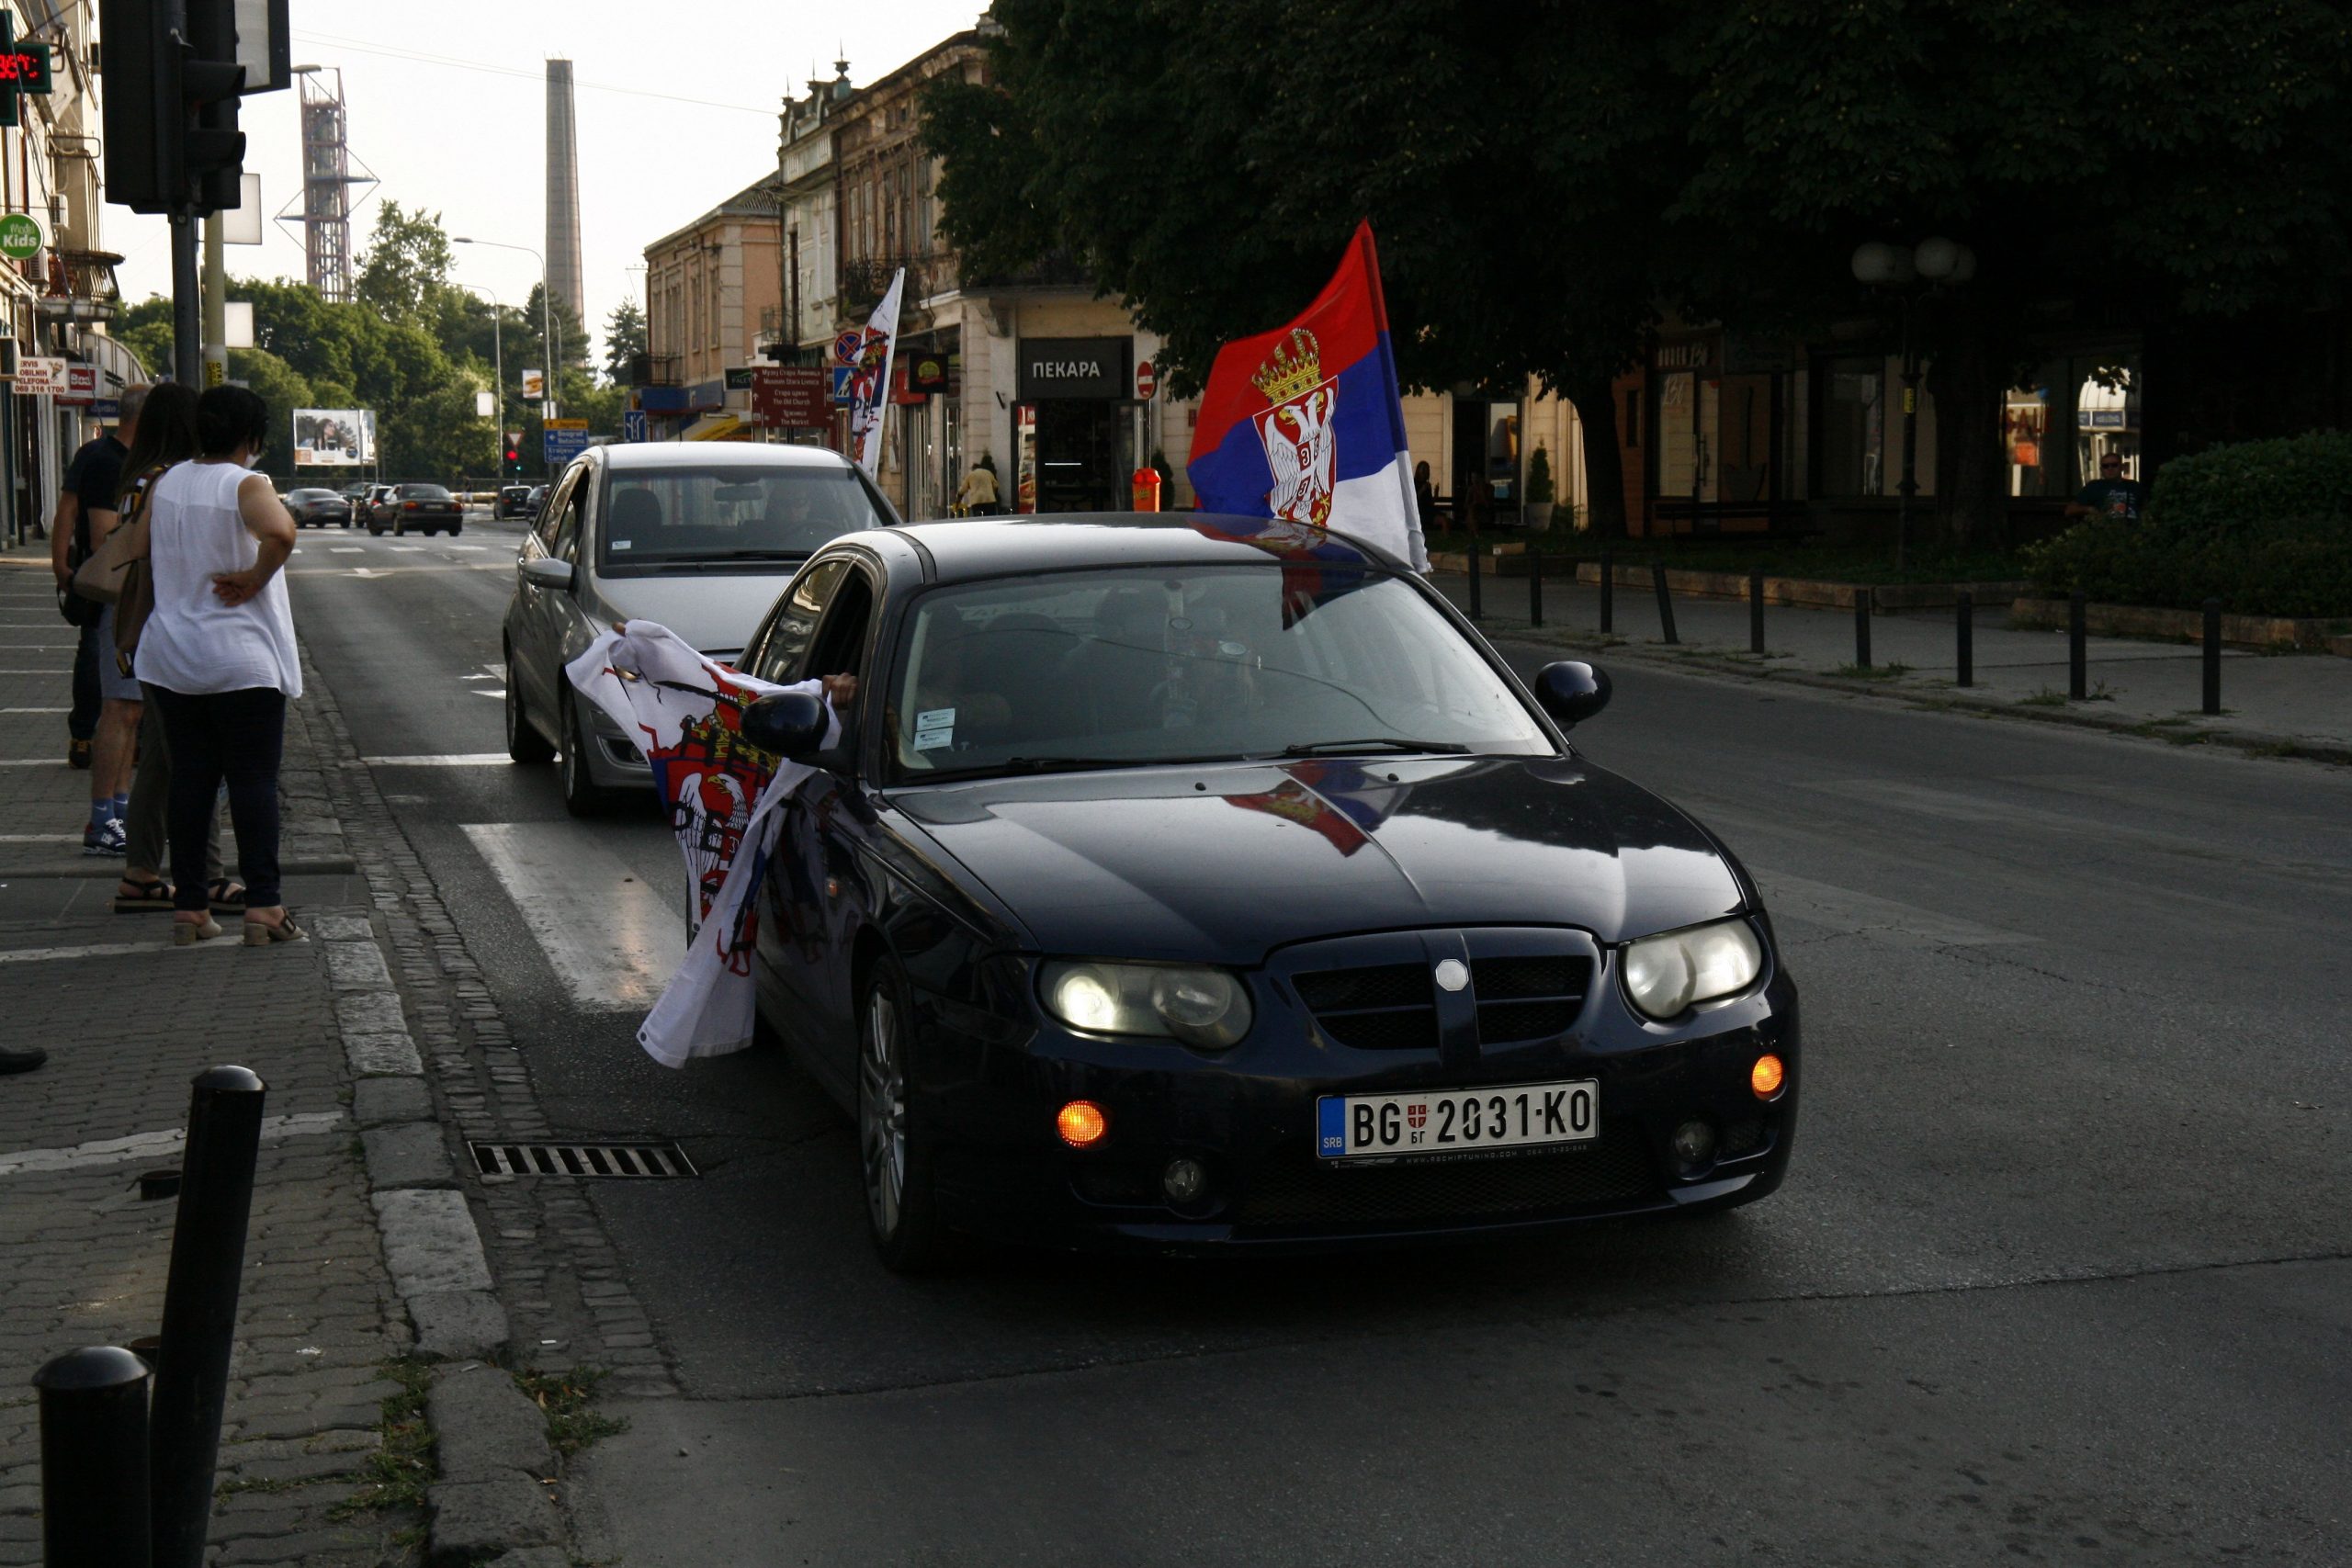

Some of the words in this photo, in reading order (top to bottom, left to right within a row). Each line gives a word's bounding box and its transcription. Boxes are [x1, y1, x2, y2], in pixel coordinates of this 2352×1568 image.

[3, 234, 37, 247] Kids
[1033, 361, 1101, 378] ПЕКАРА
[1353, 1102, 1401, 1147] BG
[1323, 1136, 1343, 1148] SRB
[1410, 1130, 1426, 1145] БГ
